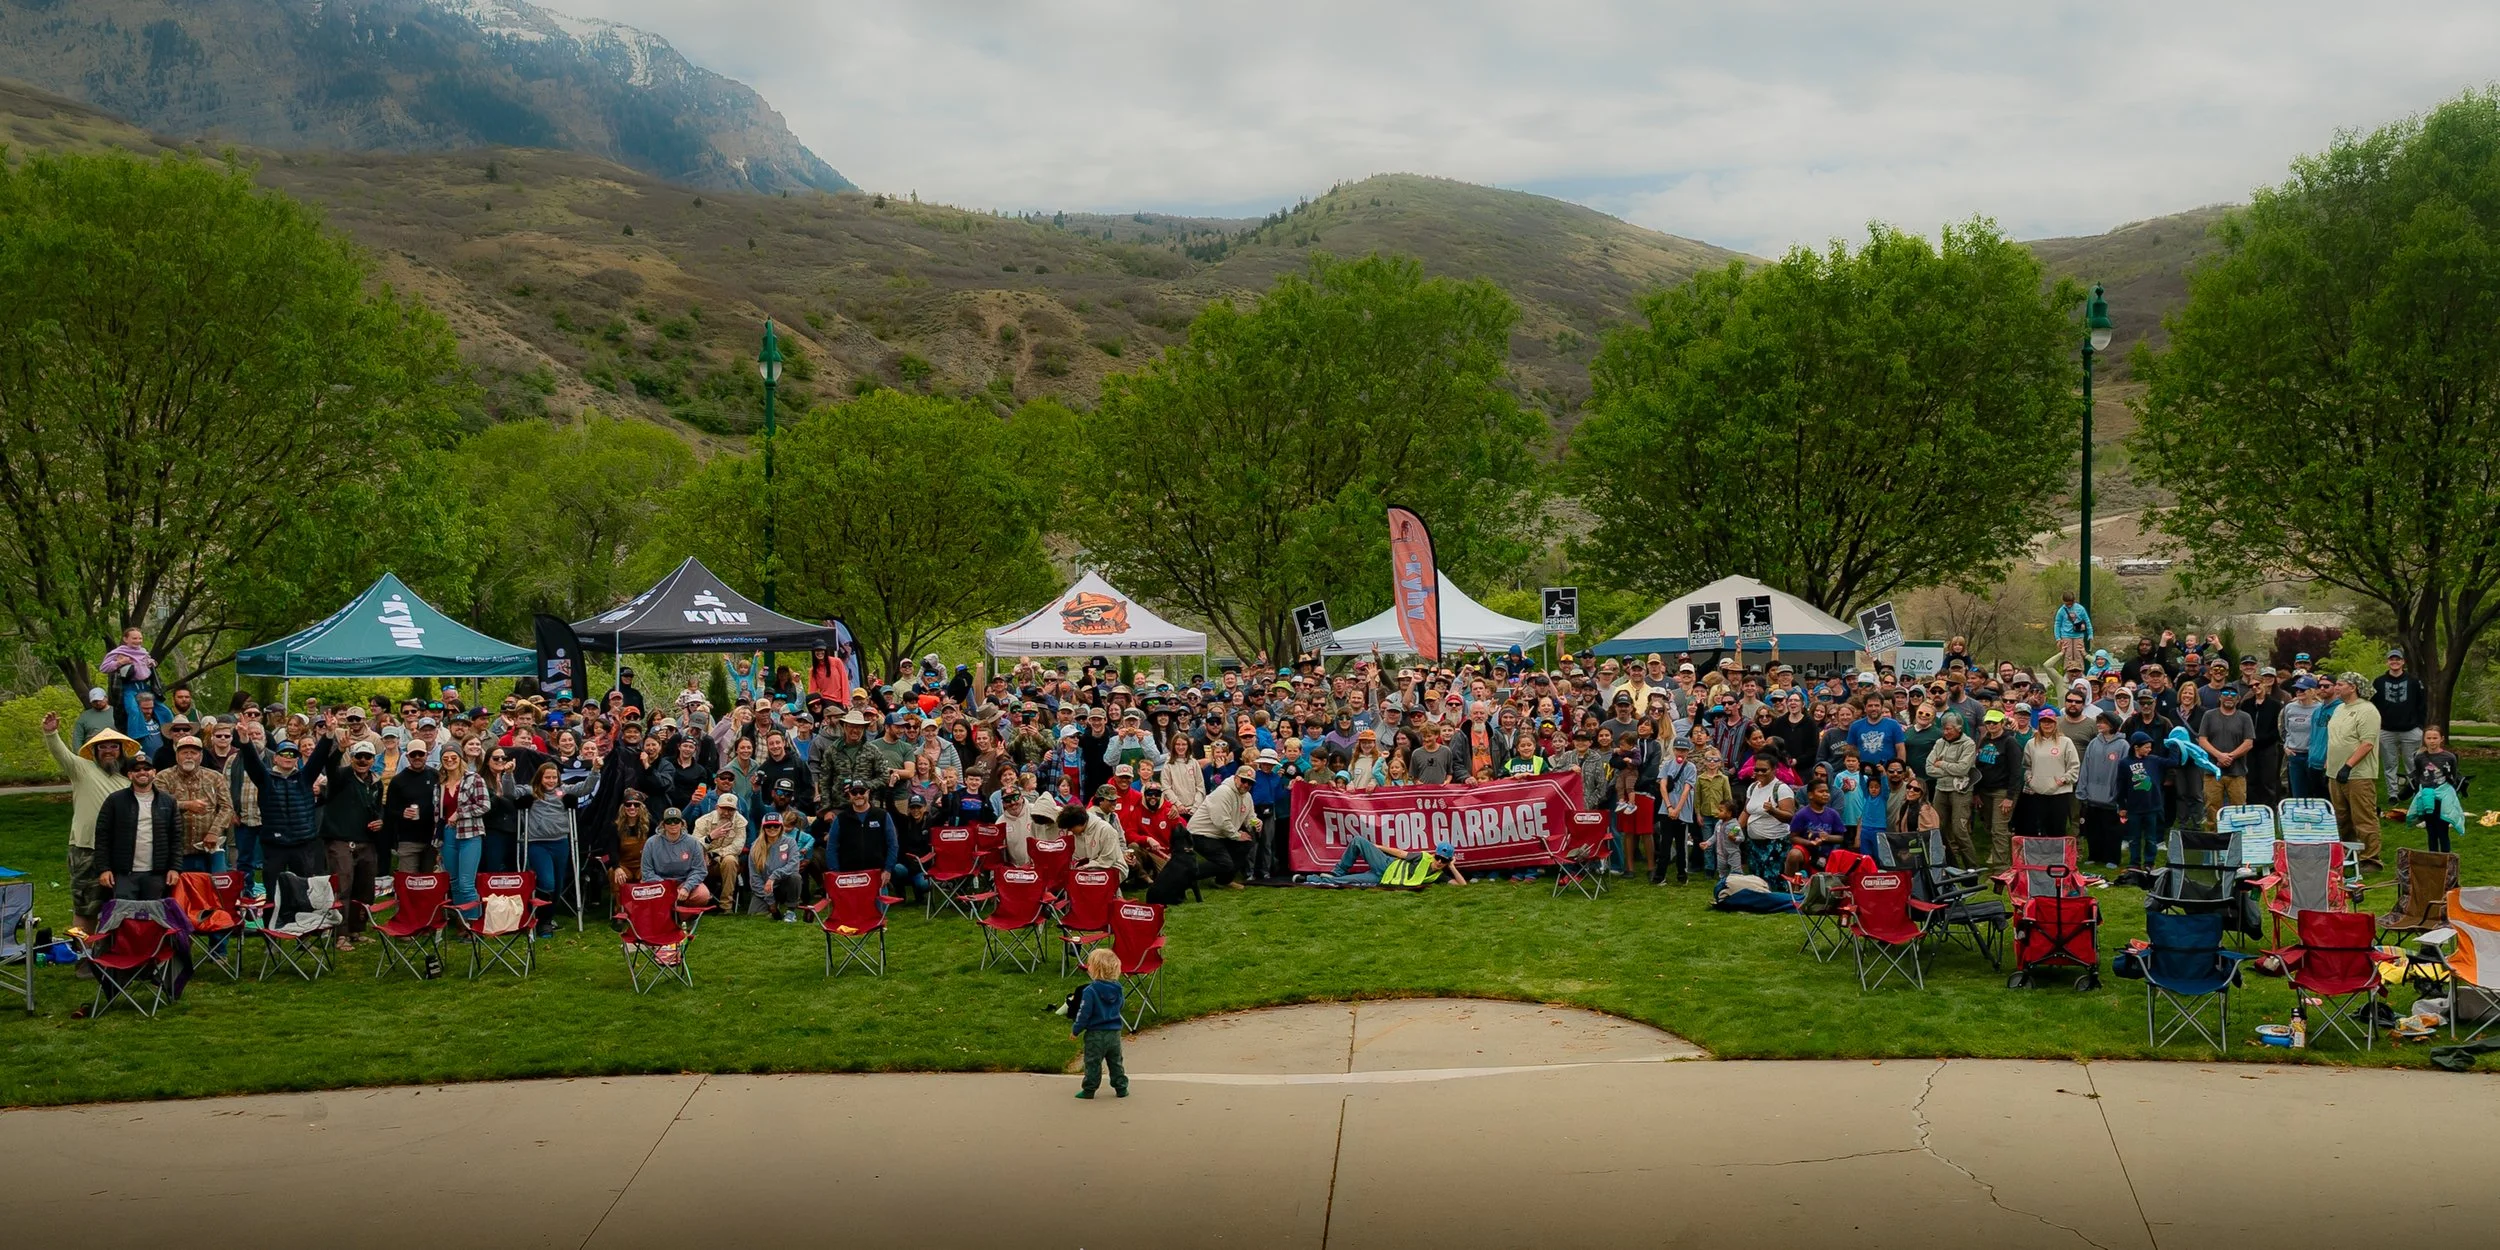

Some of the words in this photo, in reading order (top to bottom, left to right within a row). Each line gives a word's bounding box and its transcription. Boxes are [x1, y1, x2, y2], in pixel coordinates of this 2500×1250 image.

[1401, 562, 1429, 621] kyhv
[683, 608, 749, 625] kyhv
[1545, 617, 1576, 625] FISHING
[377, 601, 426, 650] kyhv
[1740, 625, 1771, 633] FISHING
[1302, 630, 1331, 643] FISHING
[1690, 631, 1720, 639] FISHING
[1868, 630, 1898, 646] FISHING
[1031, 640, 1087, 650] BANKS
[1093, 640, 1124, 649] FLY
[1130, 640, 1174, 649] RODS
[456, 655, 473, 663] Fuel
[474, 655, 491, 663] Your
[1323, 811, 1377, 846] FISH
[1381, 811, 1429, 851] FOR
[1432, 802, 1551, 849] GARBAGE
